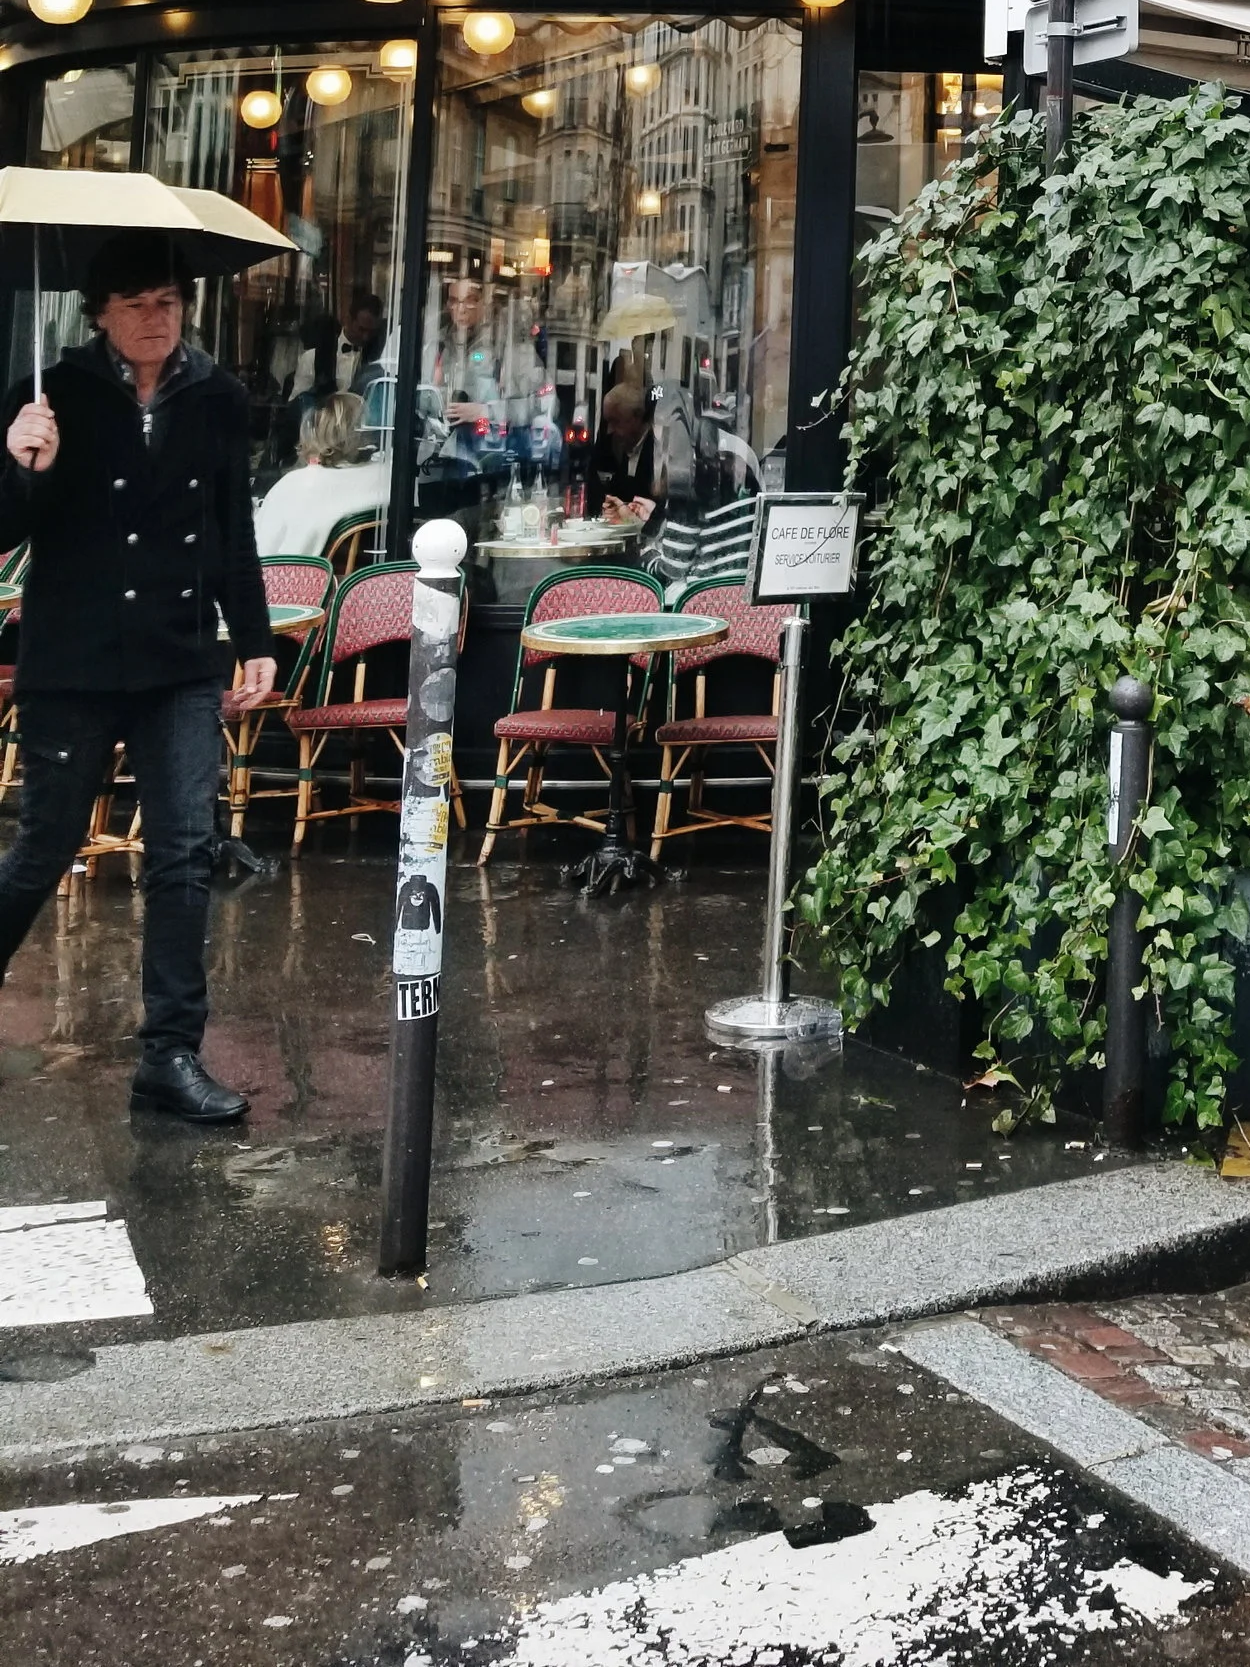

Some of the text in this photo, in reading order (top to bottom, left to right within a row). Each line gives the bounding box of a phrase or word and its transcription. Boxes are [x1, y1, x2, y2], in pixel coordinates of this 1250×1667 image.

[771, 526, 850, 540] CAFE DE FLORE
[774, 553, 803, 566] SERVICE
